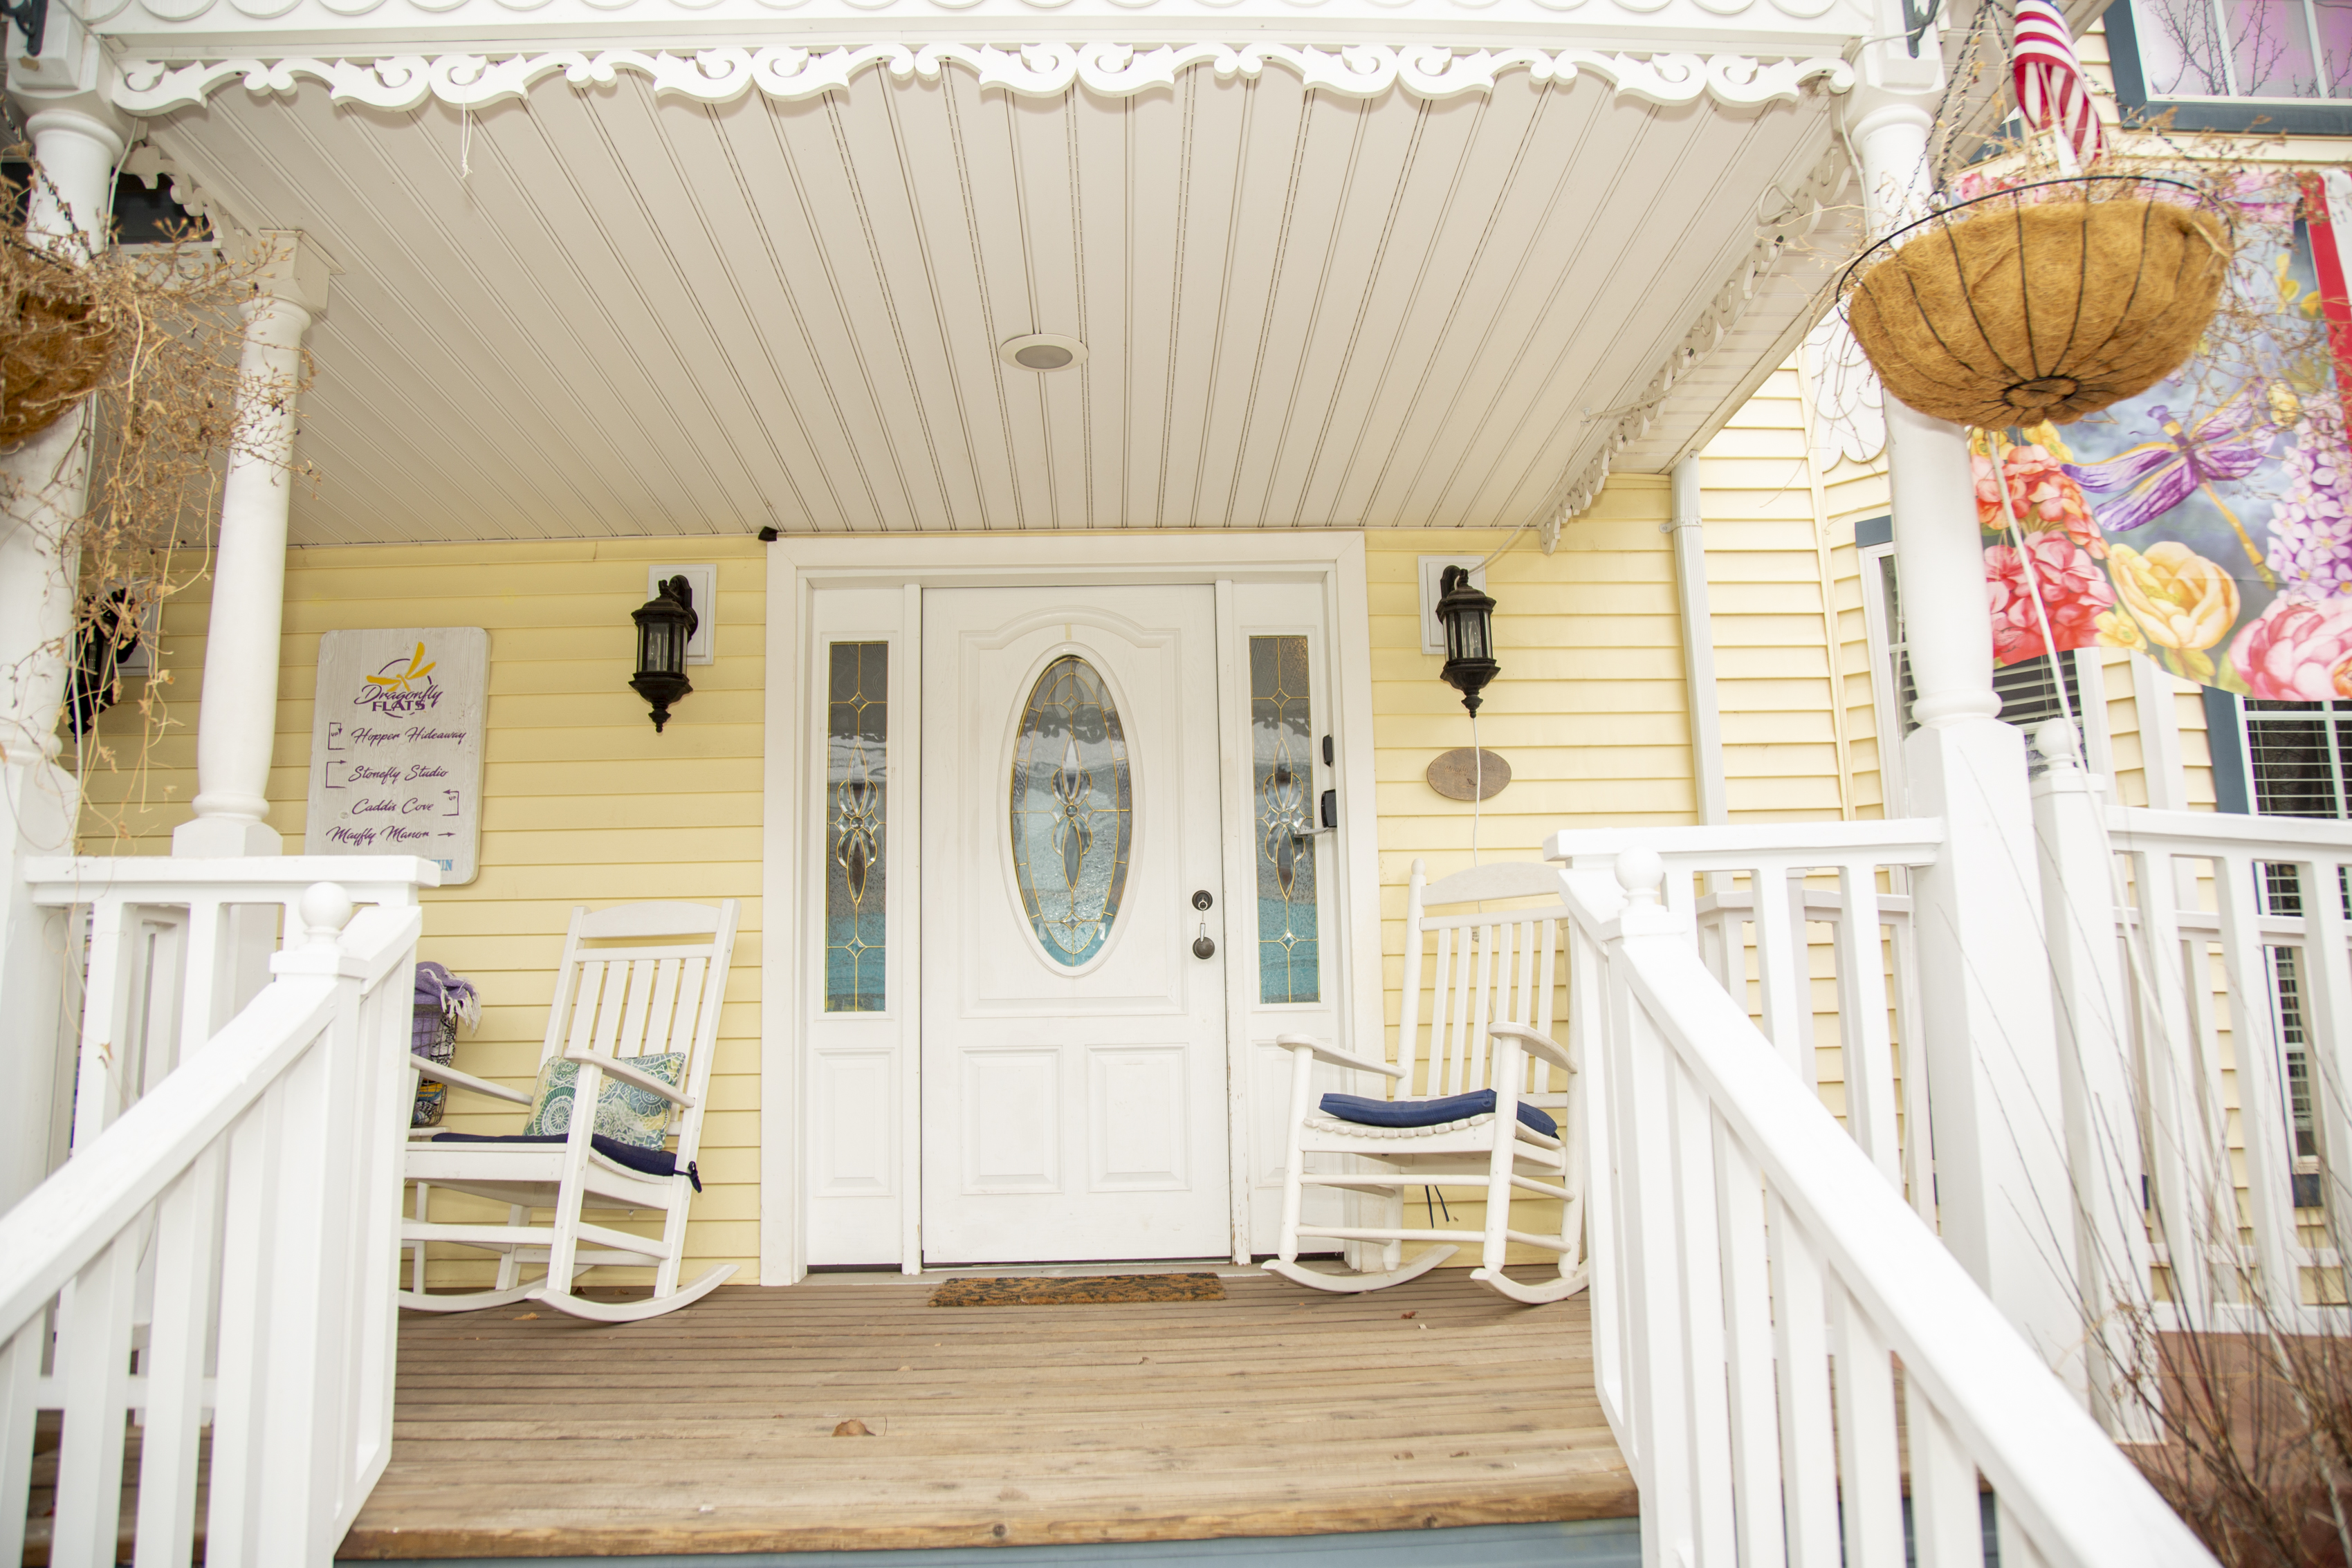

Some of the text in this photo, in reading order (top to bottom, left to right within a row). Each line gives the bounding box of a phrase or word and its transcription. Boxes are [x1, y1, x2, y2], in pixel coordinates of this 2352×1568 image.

[353, 684, 443, 709] Dragonfly
[371, 700, 425, 712] FLATS
[351, 726, 467, 747] Hopper Hideaway
[348, 764, 449, 785] Stonefly Studio
[351, 797, 434, 815] Caddis Cove
[326, 825, 430, 847] Mayfly Manor
